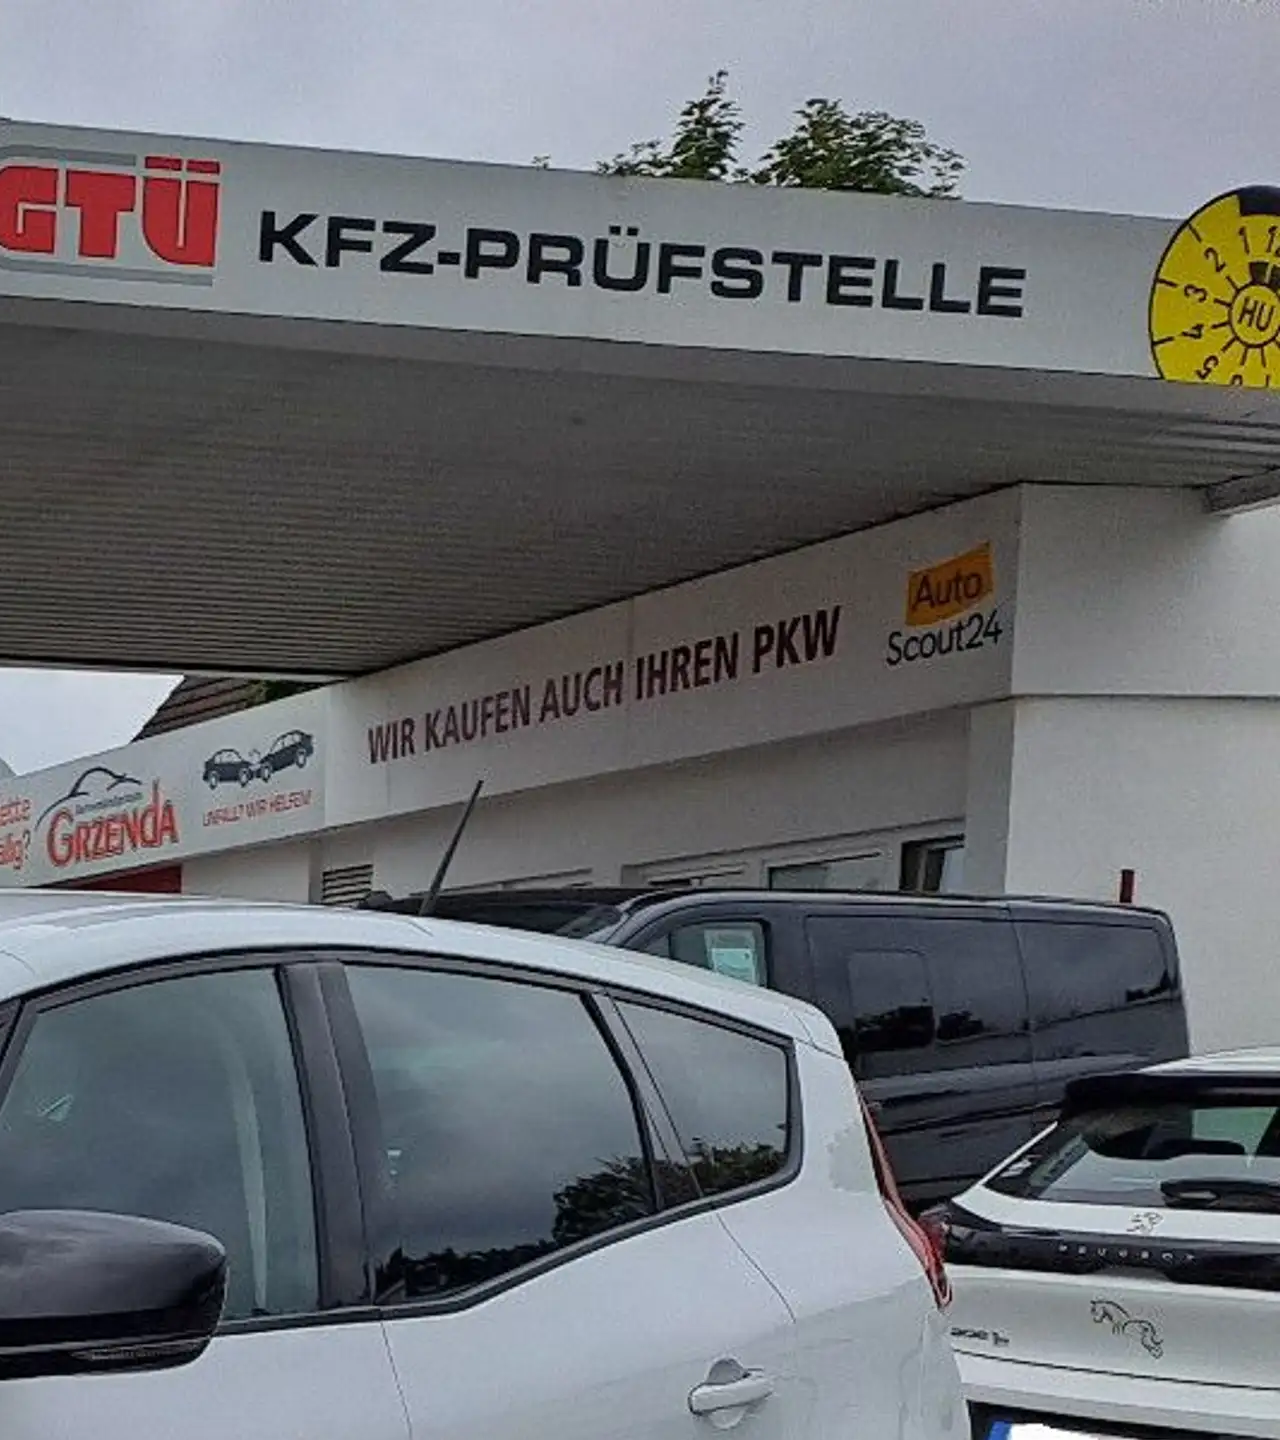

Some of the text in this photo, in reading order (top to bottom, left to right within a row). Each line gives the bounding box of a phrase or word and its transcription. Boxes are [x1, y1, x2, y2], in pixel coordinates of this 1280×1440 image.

[259, 209, 1027, 318] KFZ-PRÜFSTELLE
[1204, 247, 1227, 273] 2
[1184, 283, 1208, 303] 3
[1181, 323, 1205, 339] 4
[1239, 297, 1276, 332] HU
[1196, 355, 1219, 380] 5
[911, 563, 985, 611] Auto
[886, 609, 1003, 666] Scout24
[367, 605, 842, 764] WIR KAUFEN AUCH IHREN PKW
